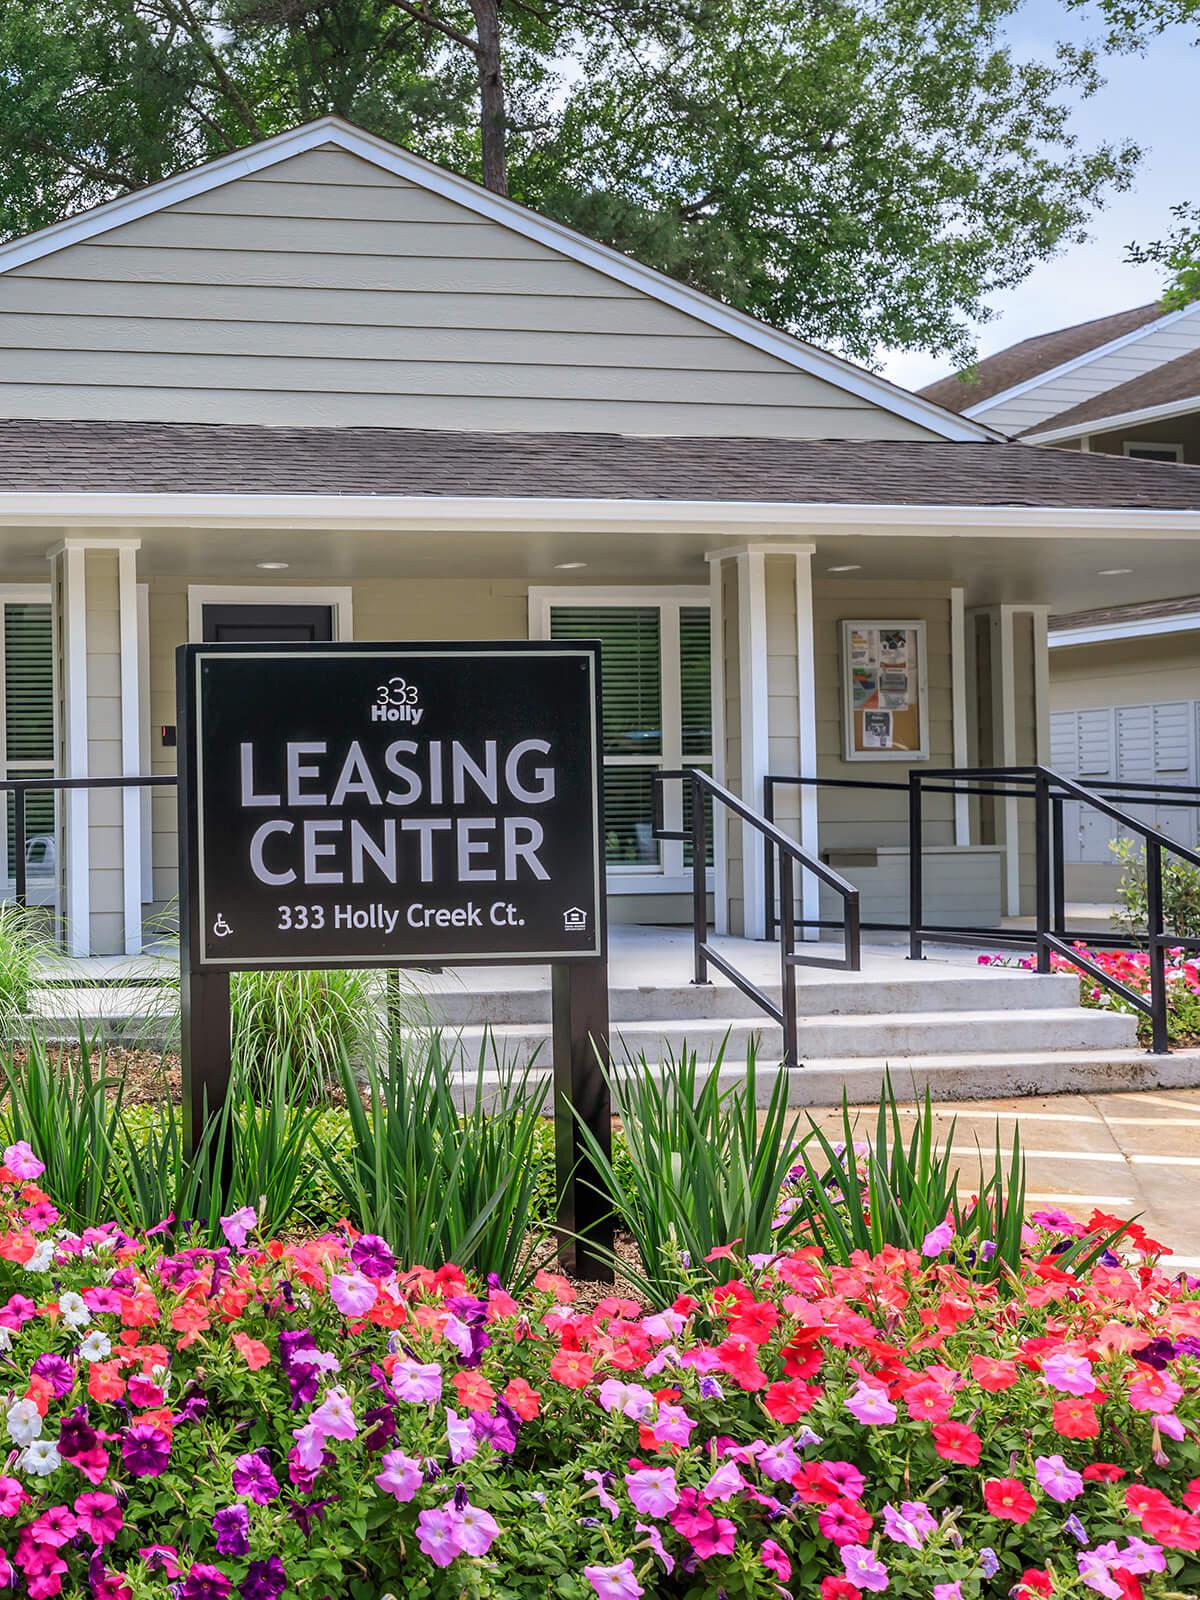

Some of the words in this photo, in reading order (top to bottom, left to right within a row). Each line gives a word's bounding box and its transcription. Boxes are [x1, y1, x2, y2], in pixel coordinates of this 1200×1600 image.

[376, 677, 419, 705] 333
[371, 704, 424, 725] Holly
[240, 738, 556, 807] LEASING
[249, 816, 552, 886] CENTER
[277, 905, 326, 930] 333
[334, 903, 400, 934] Holly
[406, 902, 484, 928] Creek
[489, 901, 526, 927] Ct.
